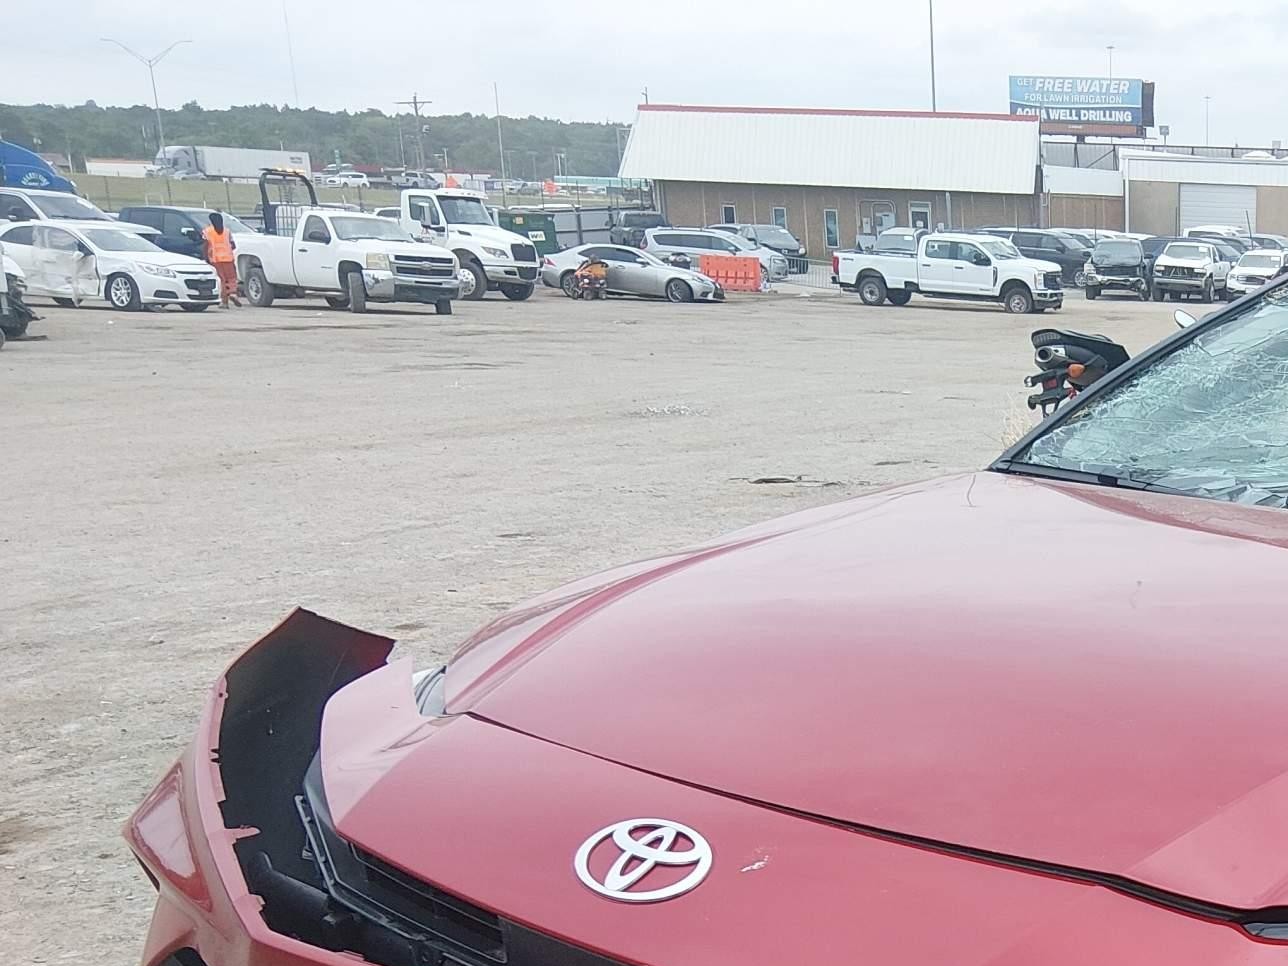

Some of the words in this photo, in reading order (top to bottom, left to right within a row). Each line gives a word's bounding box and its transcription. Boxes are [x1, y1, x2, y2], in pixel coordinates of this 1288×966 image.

[1017, 78, 1033, 86] GET
[1035, 78, 1073, 92] FREE
[1075, 79, 1130, 94] WATER
[1024, 93, 1042, 101] FOR
[1044, 94, 1070, 102] LAWN
[1071, 94, 1122, 104] IRRIGATION
[1049, 108, 1079, 121] WELL
[1080, 109, 1132, 122] DRILLING
